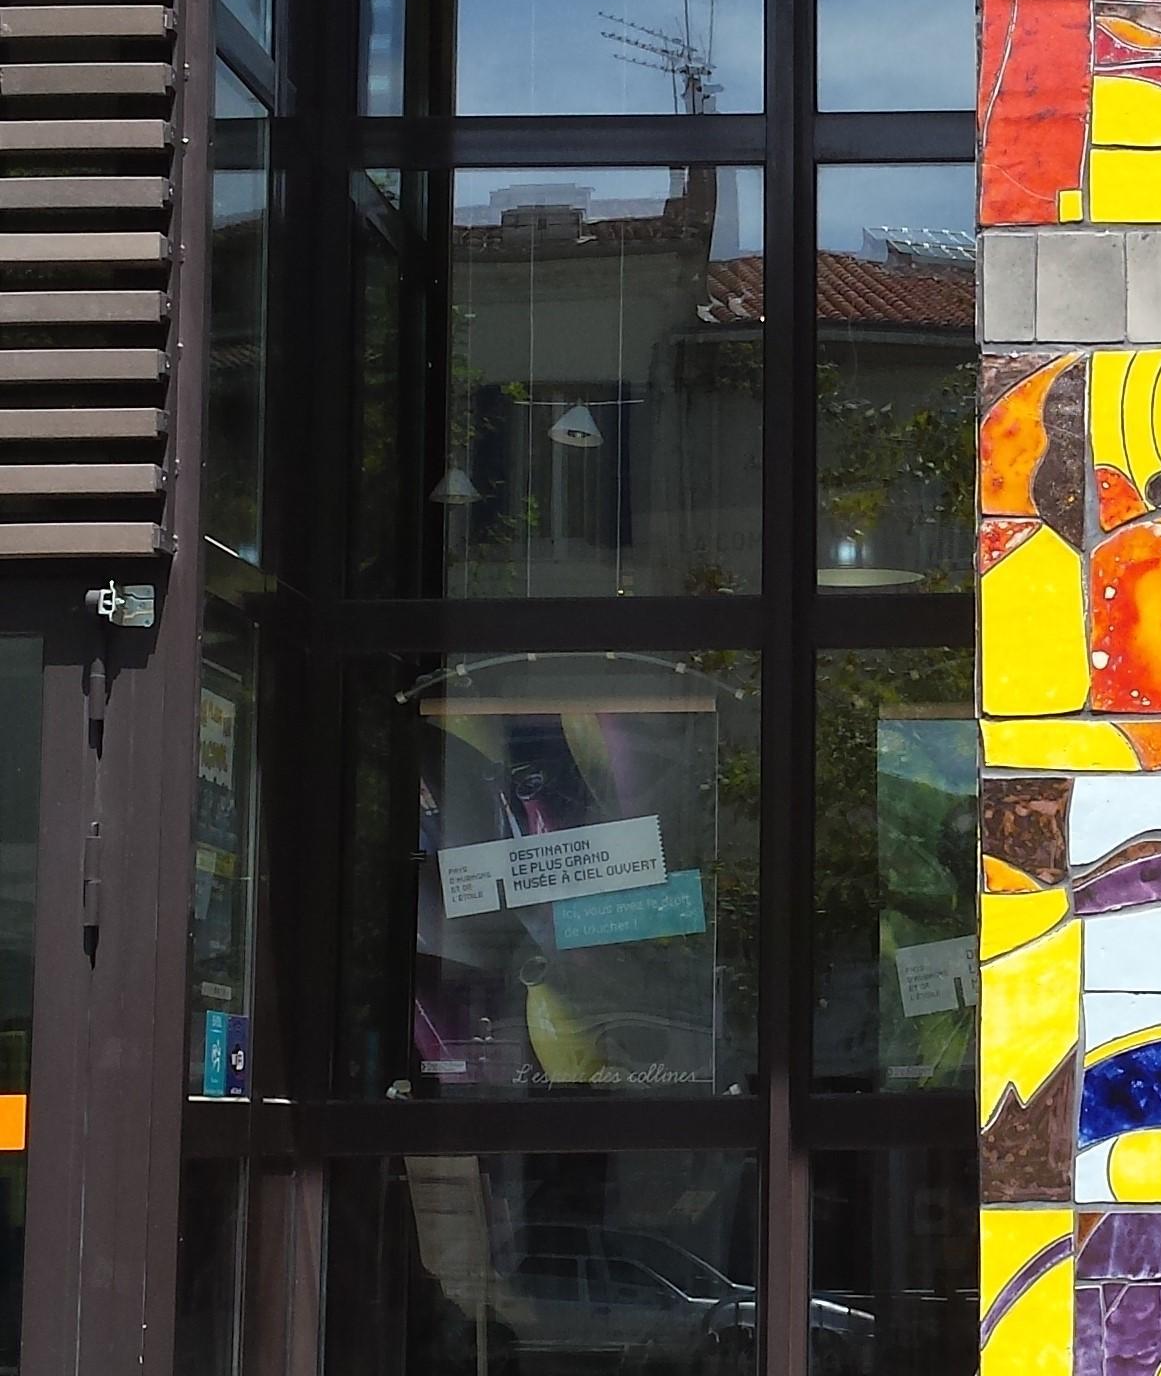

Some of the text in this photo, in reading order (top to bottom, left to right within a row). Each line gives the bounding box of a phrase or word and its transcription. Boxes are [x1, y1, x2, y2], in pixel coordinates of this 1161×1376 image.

[509, 840, 590, 862] DESTINATION
[511, 851, 610, 876] LE PLUS GRAND
[513, 859, 658, 891] MUSÉE À CIEL OUVERT
[589, 1065, 622, 1084] des
[626, 1063, 698, 1084] collines
